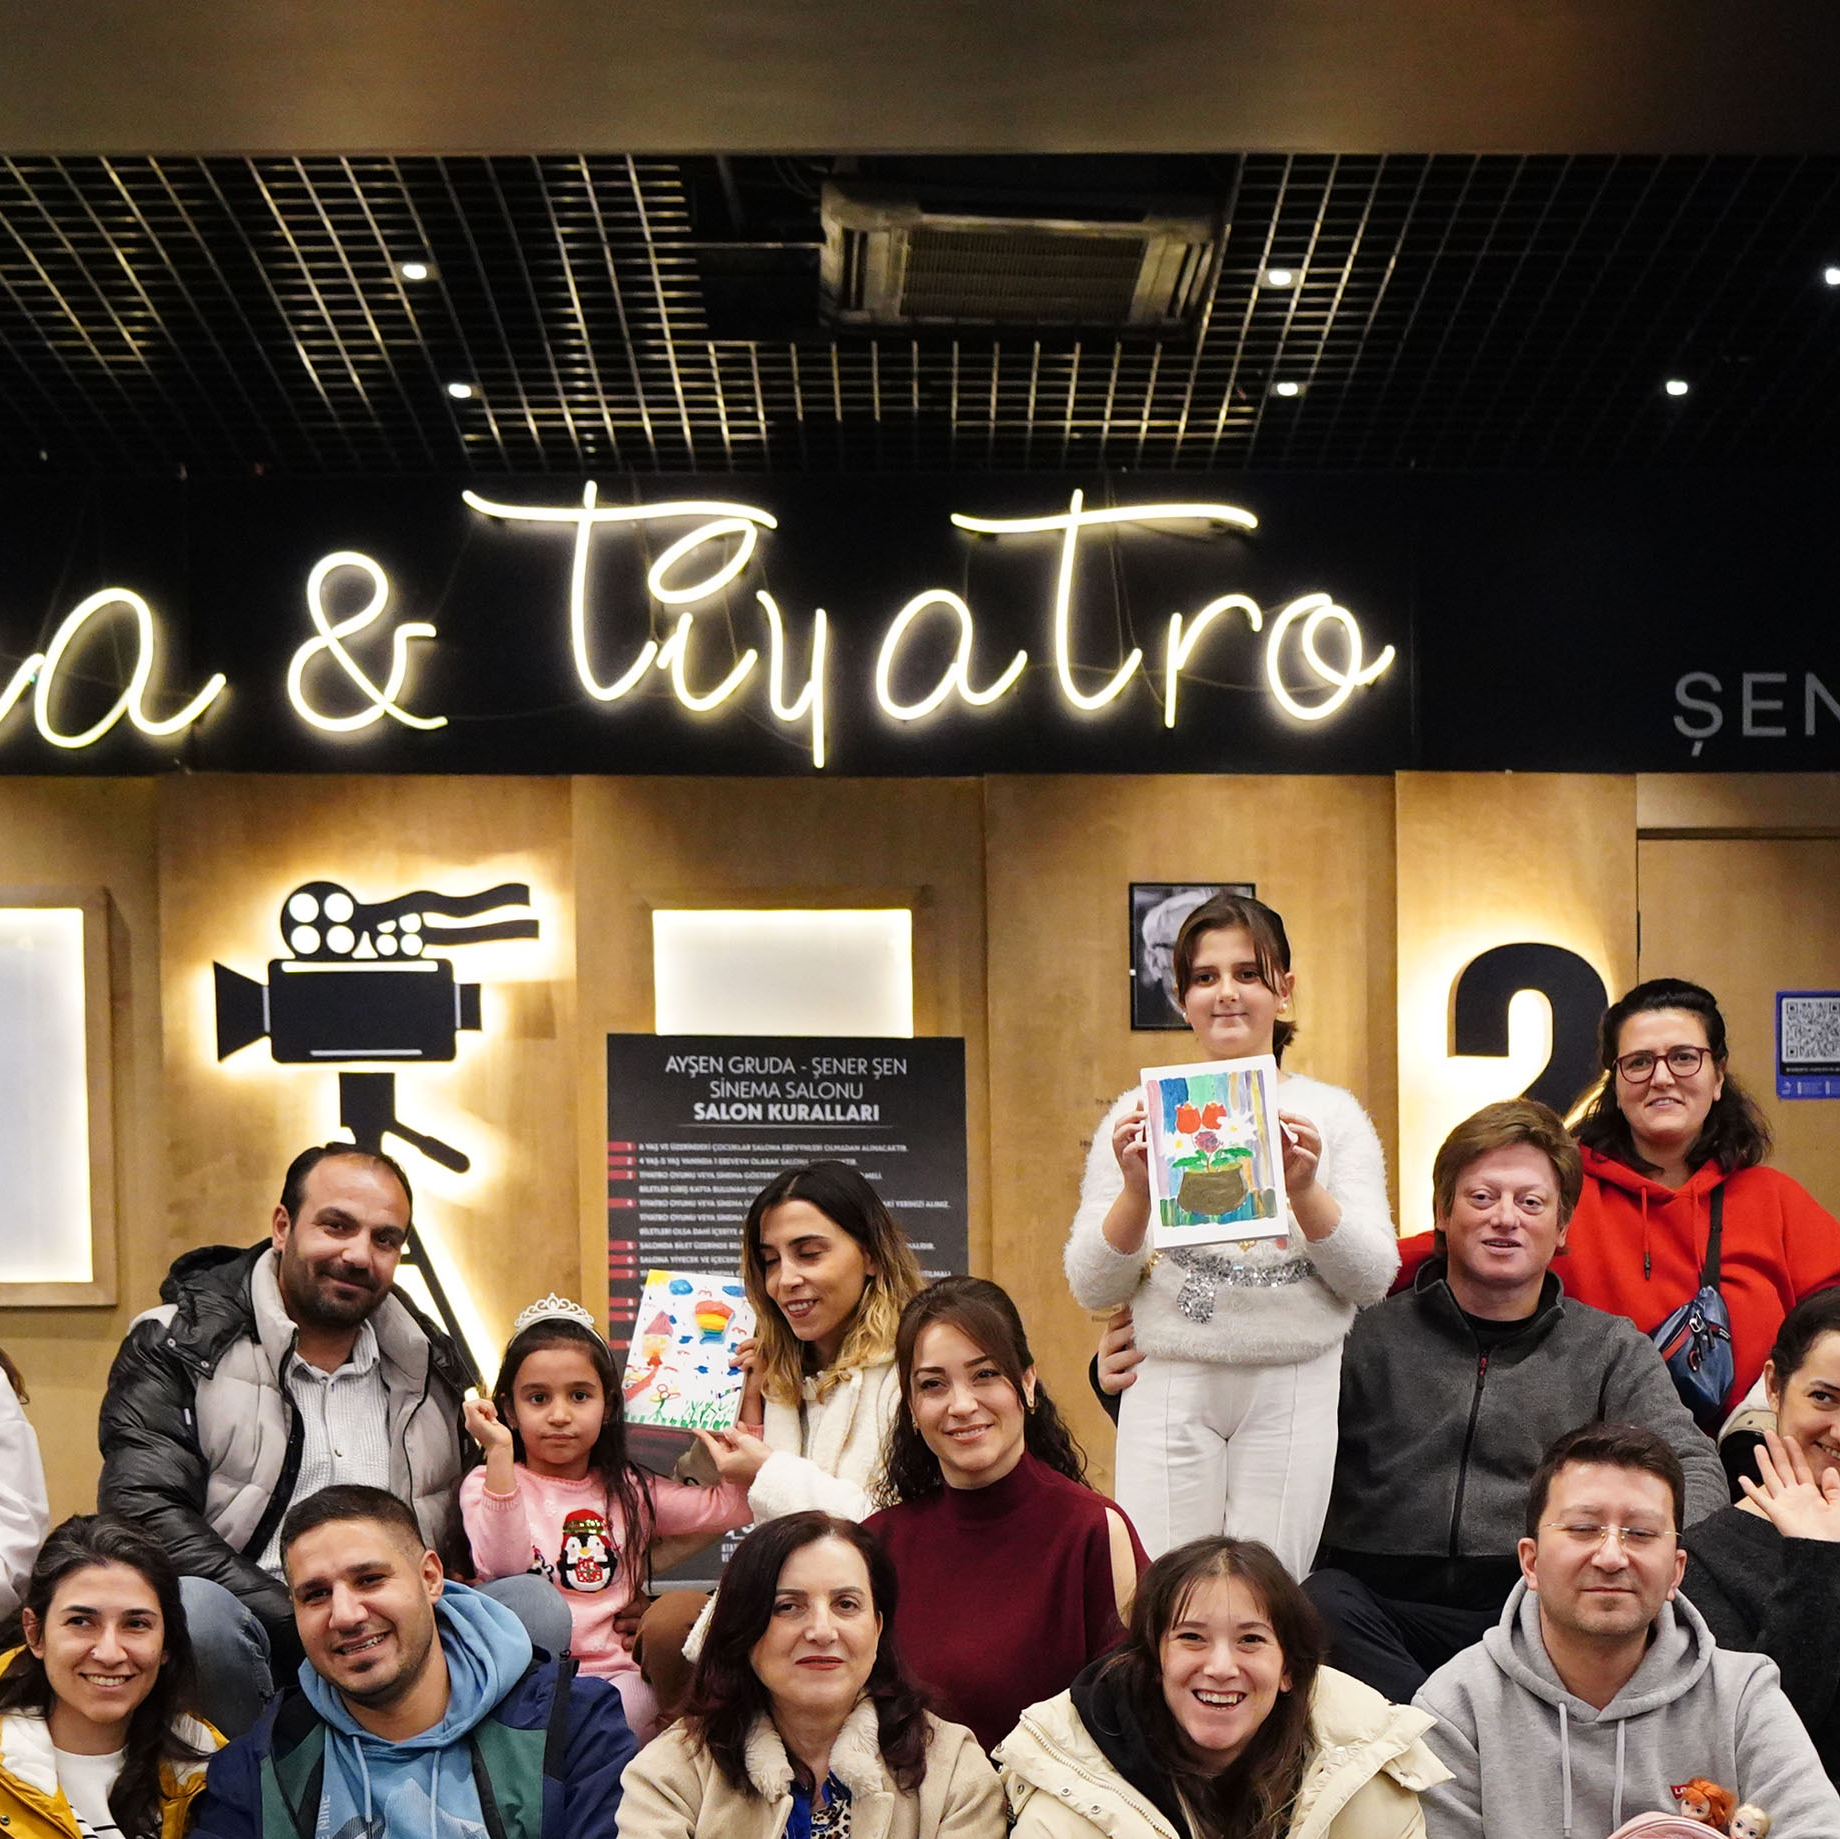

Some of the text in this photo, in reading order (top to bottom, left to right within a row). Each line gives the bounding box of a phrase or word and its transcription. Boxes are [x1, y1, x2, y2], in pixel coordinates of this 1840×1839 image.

[288, 550, 448, 732] &
[1447, 942, 1611, 1124] 2
[665, 1056, 723, 1078] AYŞEN
[728, 1056, 796, 1074] GRUDA
[812, 1057, 867, 1079] ŞENER
[872, 1058, 907, 1079] ŞEN
[710, 1077, 863, 1099] SİNEMA SALONU
[693, 1103, 879, 1121] SALON KURALLARI
